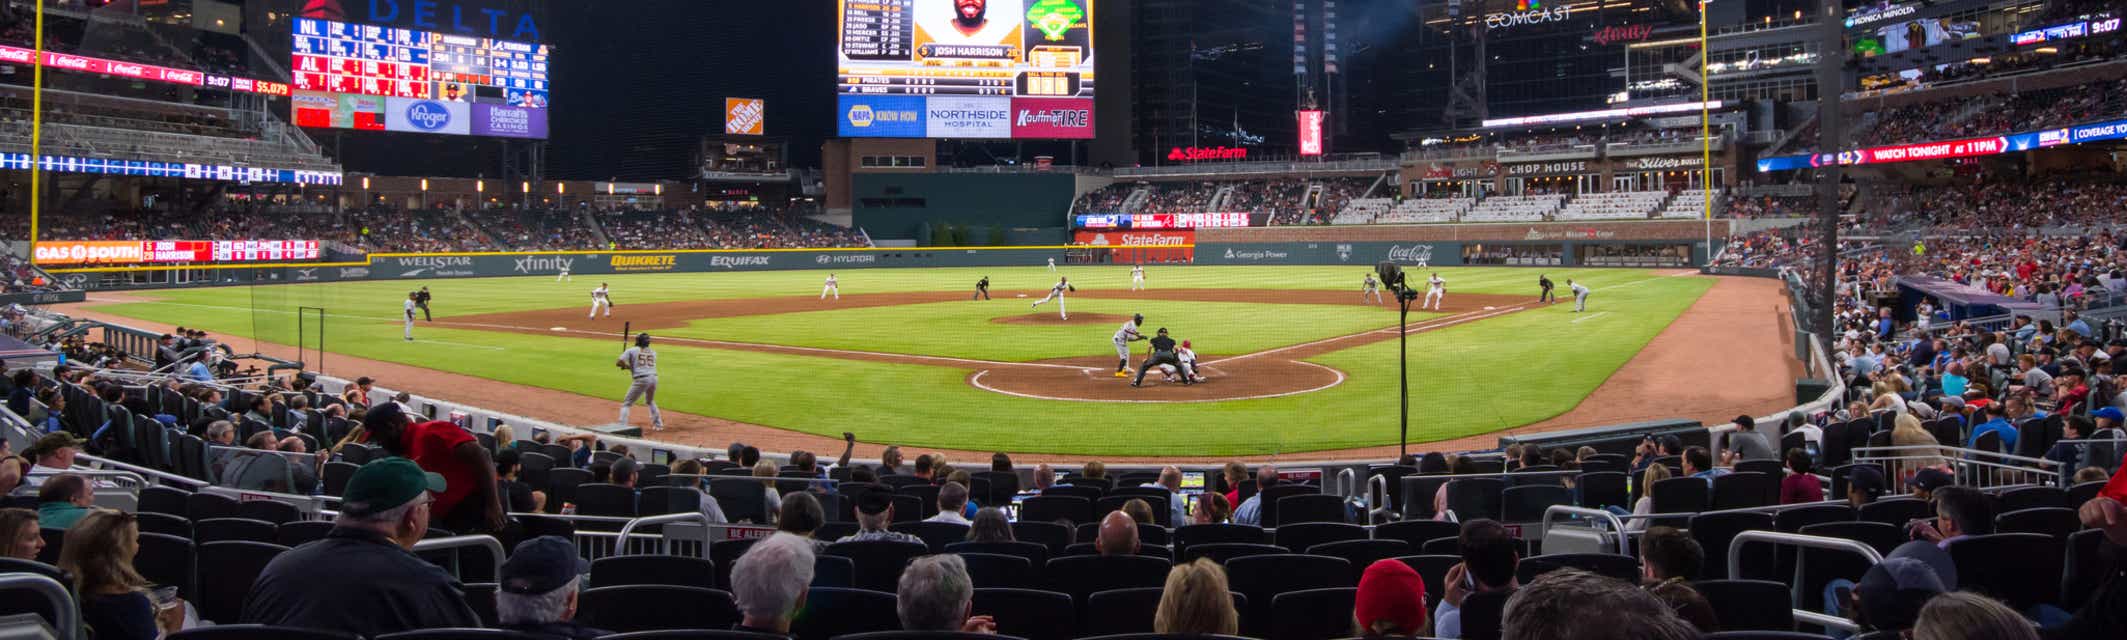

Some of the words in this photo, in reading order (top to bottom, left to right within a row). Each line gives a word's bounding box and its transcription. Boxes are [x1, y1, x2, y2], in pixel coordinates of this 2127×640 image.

[369, 0, 540, 42] DELTA
[1486, 5, 1573, 29] COMCAST
[1855, 13, 1882, 25] KONICA
[1882, 6, 1915, 18] MINOLTA
[300, 20, 319, 35] NL
[2092, 18, 2120, 33] 9:07
[1593, 24, 1652, 46] xfinity
[935, 46, 956, 57] JOSH
[957, 47, 1003, 57] HARRISON
[300, 56, 319, 71] AL
[207, 75, 229, 87] 9:07
[411, 104, 447, 128] Kroger
[726, 99, 763, 134] HOME
[852, 110, 871, 121] NAPA
[930, 109, 1008, 120] NORTHSIDE
[1053, 109, 1088, 128] TIRE
[490, 122, 528, 130] CASINOS
[944, 120, 993, 128] HOSPITAL
[2078, 125, 2115, 140] COVERAGE
[1184, 146, 1247, 160] StateFarm
[1873, 146, 1907, 160] WATCH
[1907, 143, 1951, 158] TONIGHT
[1954, 145, 1964, 154] AT
[1967, 139, 1997, 153] 11PM
[1508, 163, 1541, 174] CHOP
[1544, 161, 1585, 172] HOUSE
[1625, 160, 1638, 169] THE
[1637, 156, 1680, 169] Silver
[1450, 168, 1478, 178] LIGHT
[155, 242, 176, 250] JOSH
[1120, 233, 1185, 247] StateFarm
[35, 246, 70, 260] GAS
[89, 245, 140, 259] SOUTH
[833, 255, 875, 263] HYUNDAI
[1236, 249, 1264, 260] Georgia
[1265, 249, 1288, 259] Power
[1388, 244, 1434, 261] Coca-Cola
[398, 256, 472, 270] WELLSTAR
[515, 256, 574, 273] xfinity
[609, 254, 677, 267] QUIKRETE
[709, 255, 770, 270] EQUIFAX
